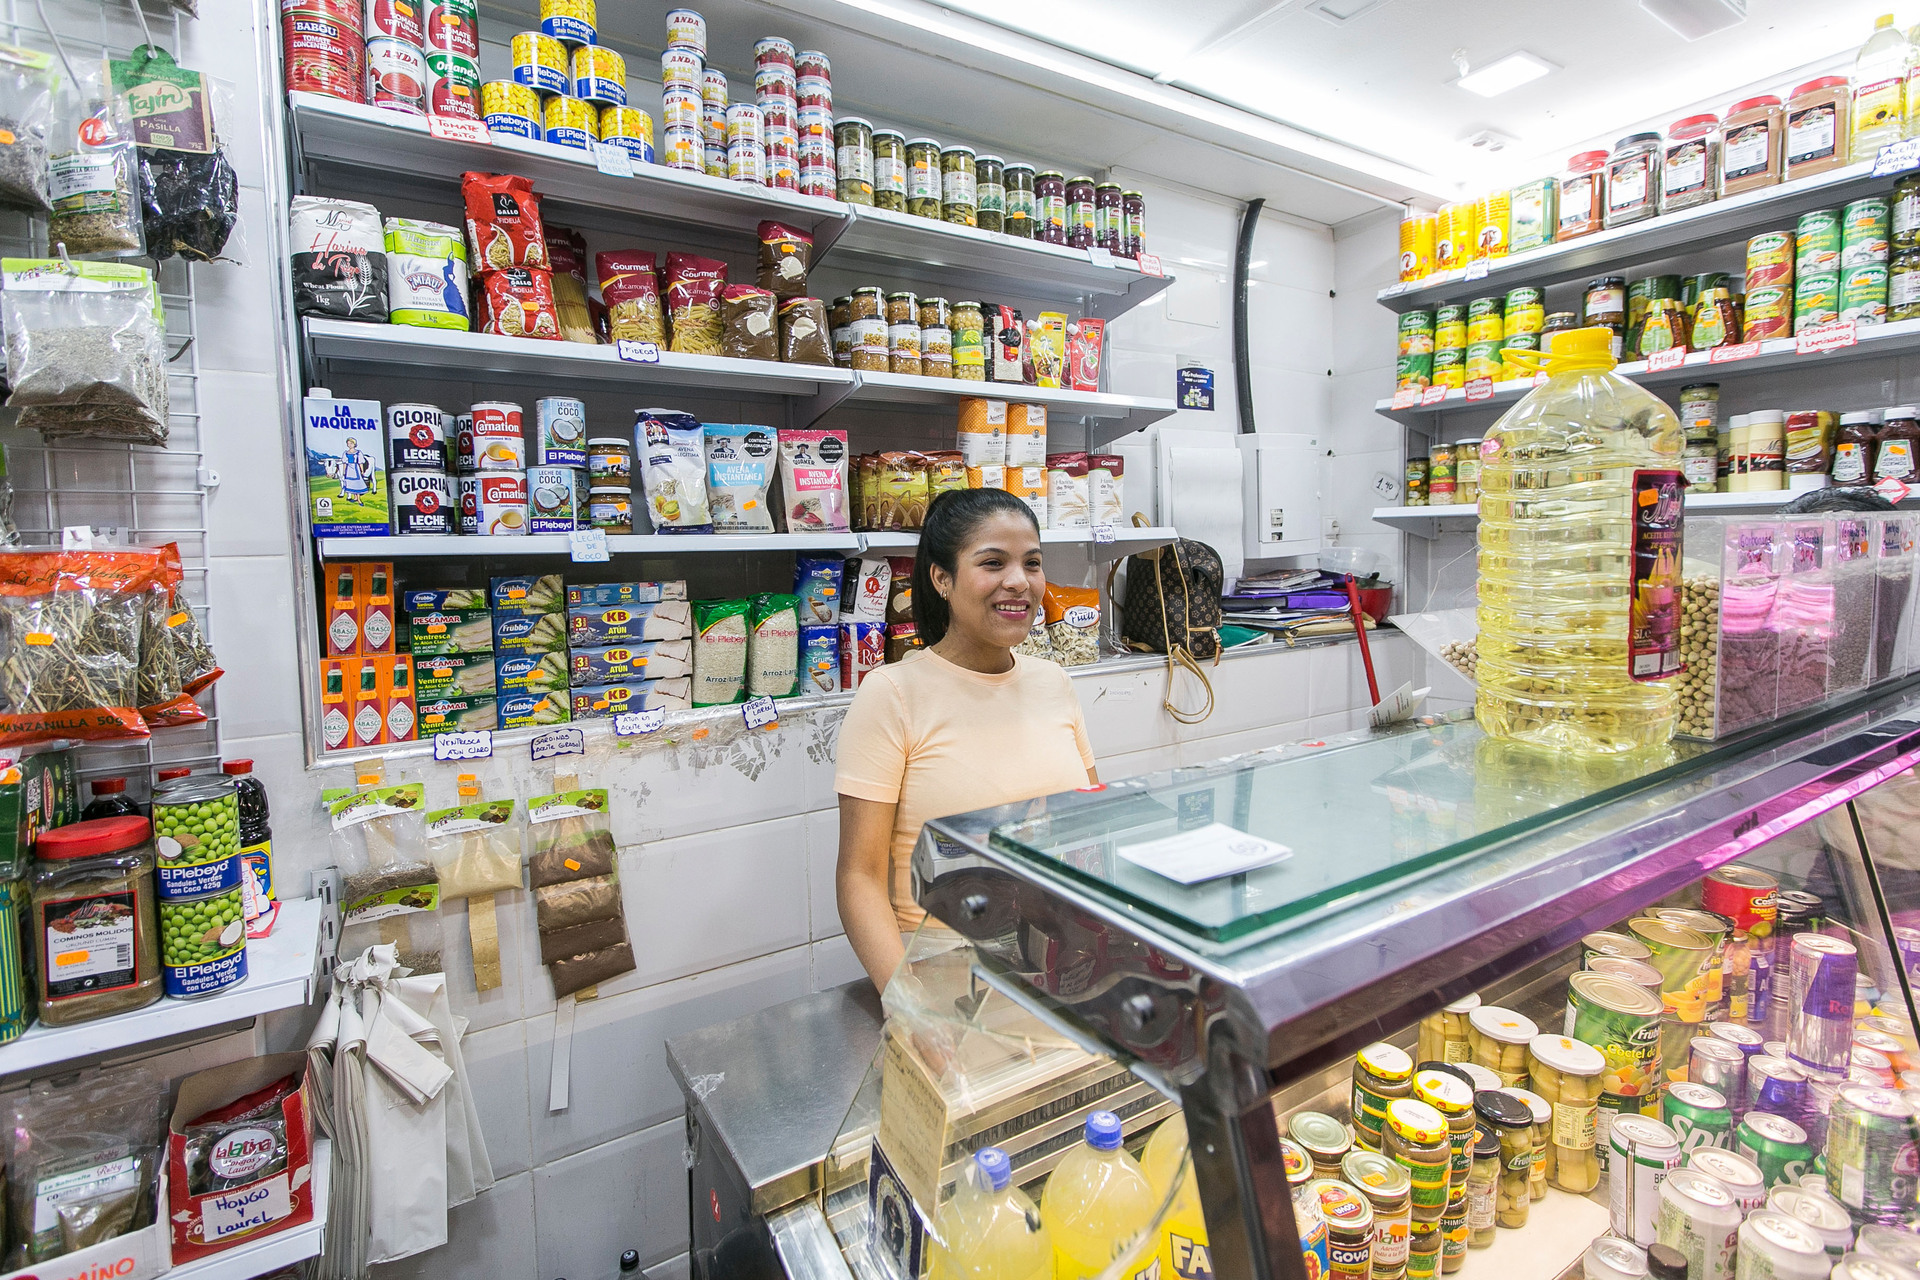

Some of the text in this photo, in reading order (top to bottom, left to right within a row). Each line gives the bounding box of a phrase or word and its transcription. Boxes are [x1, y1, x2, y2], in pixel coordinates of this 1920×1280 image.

[674, 17, 699, 27] ANDA
[296, 22, 339, 37] BABOU
[671, 55, 696, 66] ANDA
[445, 99, 475, 111] TOMATE
[439, 105, 480, 120] TRITURADO
[140, 119, 182, 133] PASILLA
[497, 208, 519, 216] GALLO
[310, 232, 368, 258] Harina
[612, 262, 650, 272] Gourmet
[682, 269, 718, 279] Gourmet
[334, 405, 352, 418] LA
[557, 407, 579, 417] COCO
[309, 415, 377, 431] VAQUERA
[393, 409, 443, 429] GLORIA
[475, 419, 520, 435] Carnation
[403, 448, 441, 461] LECHE
[549, 451, 557, 460] El
[538, 475, 562, 485] COCO
[808, 470, 828, 479] AVENA
[399, 476, 447, 495] GLORIA
[487, 487, 527, 502] Carnation
[408, 514, 446, 526] LECHE
[532, 520, 573, 530] El Plebeyo
[575, 532, 603, 543] LECHE
[585, 542, 597, 551] DE
[413, 615, 461, 625] PESCAMAR
[575, 617, 583, 628] 3
[606, 611, 627, 622] KB
[331, 627, 357, 635] TABASCO
[577, 656, 584, 667] 3
[608, 650, 628, 662] KB
[417, 659, 465, 670] PESCAMAR
[417, 677, 455, 685] Ventresca
[608, 689, 628, 700] KB
[420, 702, 468, 713] PESCAMAR
[577, 697, 584, 707] 3
[97, 715, 124, 727] 50g
[420, 720, 458, 729] Ventresca
[161, 862, 229, 880] El Plebeyo
[166, 873, 223, 889] Gandules Verdes
[170, 881, 222, 895] con Coco 425g
[53, 927, 134, 944] COMINOS MOLIDOS
[175, 957, 243, 978] El Plebeyo
[181, 968, 238, 987] Gandules Verdes
[186, 976, 236, 992] con Coco 425g
[1607, 1044, 1645, 1059] Coctel
[228, 1163, 257, 1175] Laurel
[215, 1187, 270, 1211] HONGO
[1332, 1249, 1369, 1263] GOYA
